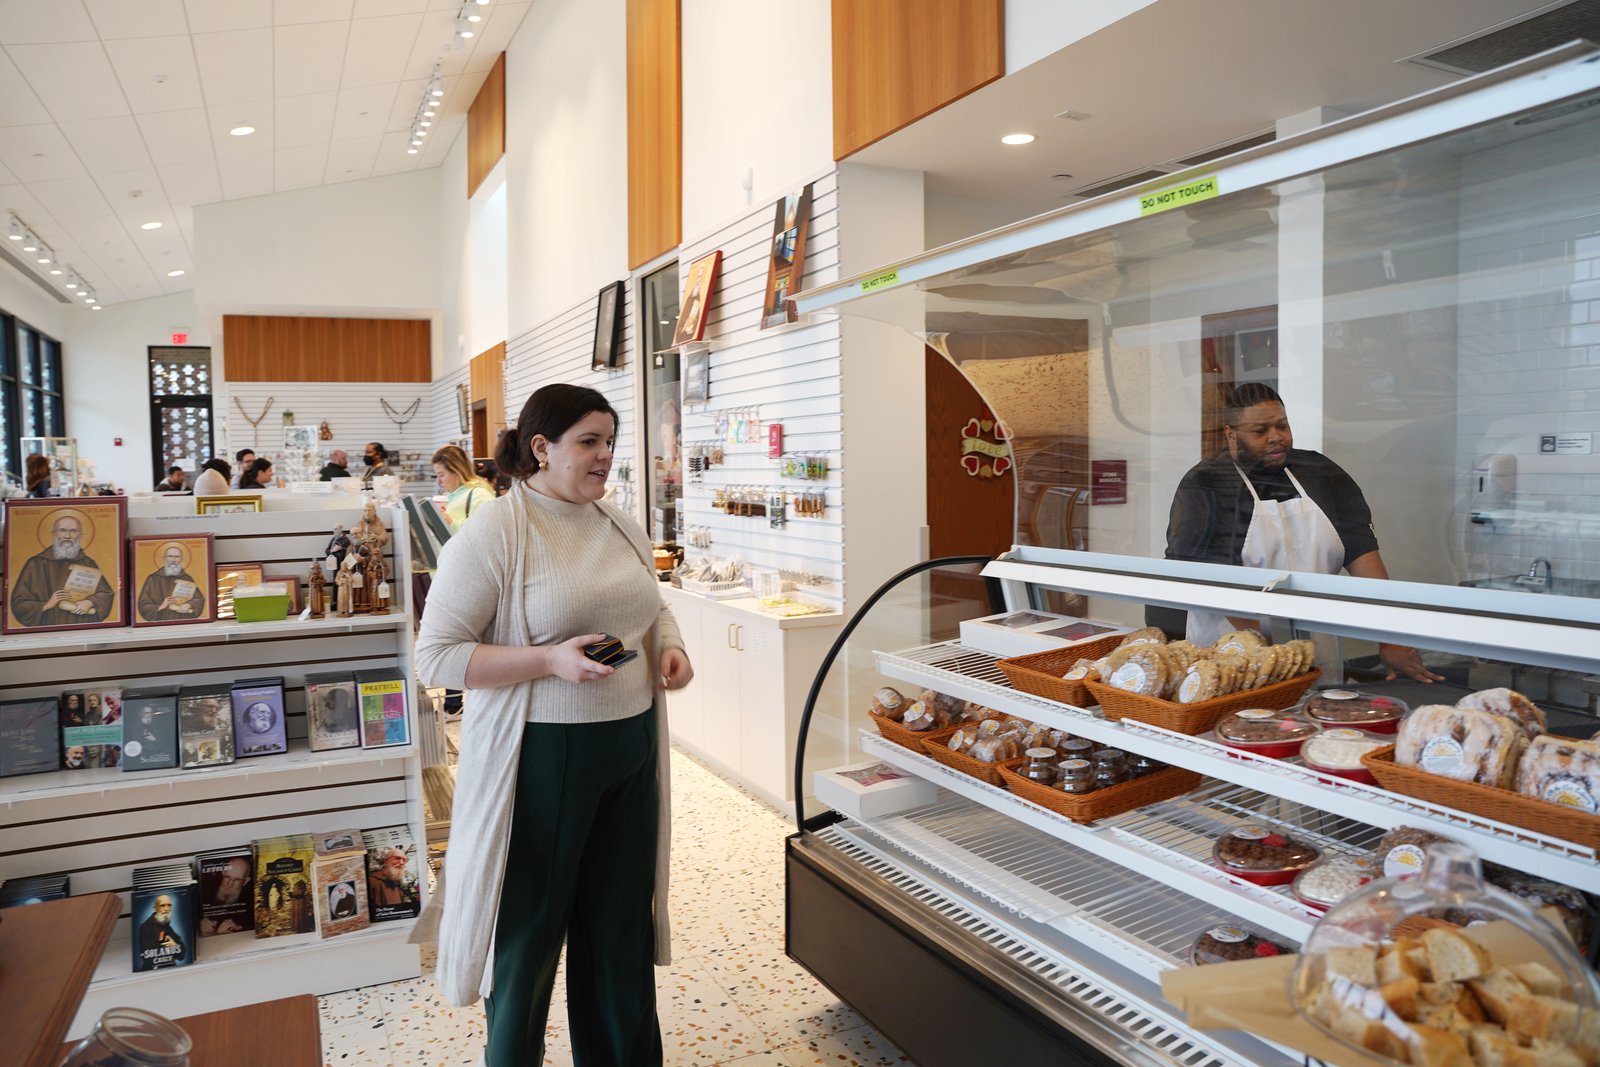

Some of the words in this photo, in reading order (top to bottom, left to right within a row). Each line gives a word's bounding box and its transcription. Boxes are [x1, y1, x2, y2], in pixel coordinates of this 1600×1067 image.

[1141, 198, 1155, 209] DO
[1156, 192, 1176, 205] NOT
[1178, 181, 1213, 198] TOUCH
[879, 273, 897, 283] TOUCH
[143, 944, 182, 959] SOLANUS
[153, 955, 173, 964] CASEY
